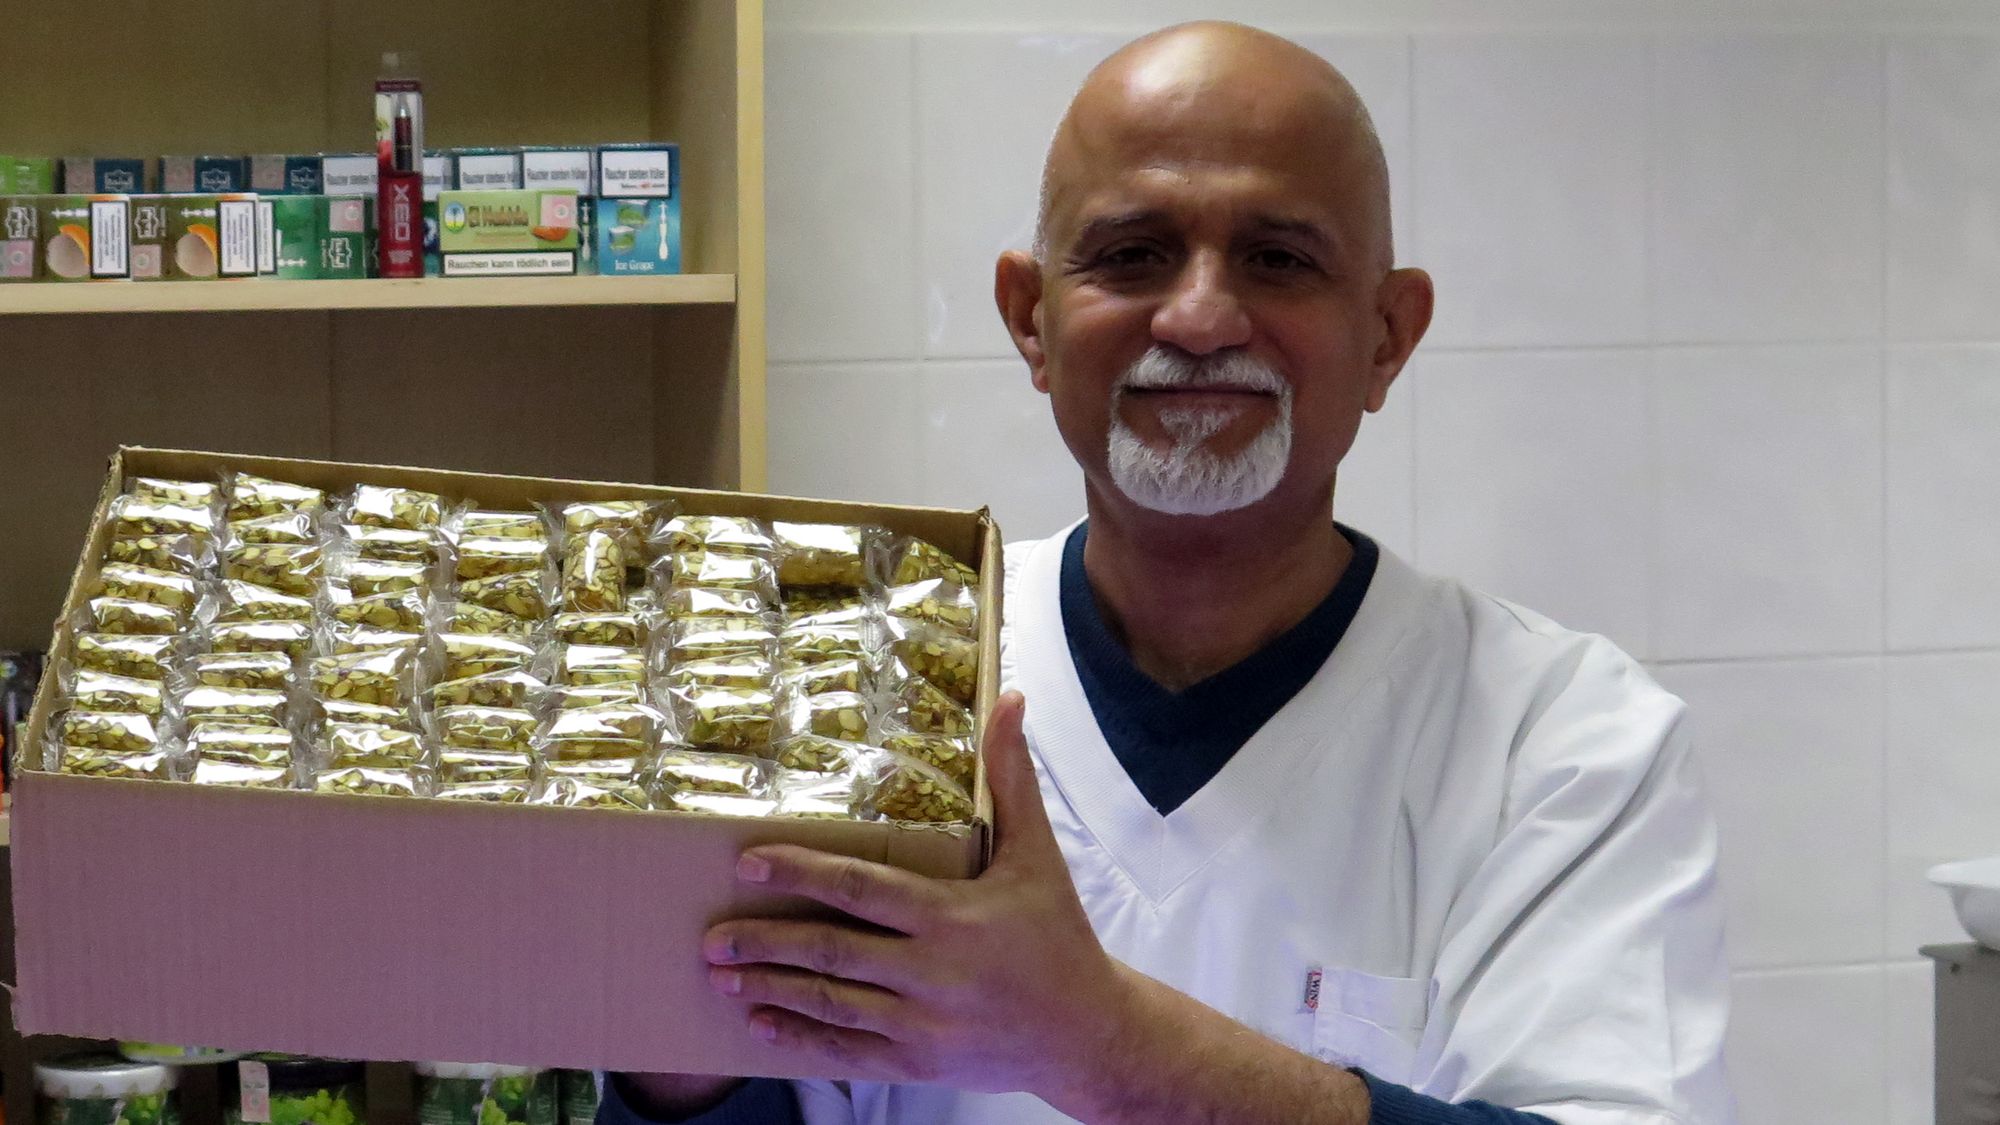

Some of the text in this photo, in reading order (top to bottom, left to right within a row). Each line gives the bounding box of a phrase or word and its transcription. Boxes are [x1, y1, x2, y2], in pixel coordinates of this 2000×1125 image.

[447, 258, 569, 269] Rauchen kann tödlich sein
[615, 259, 627, 270] Ice
